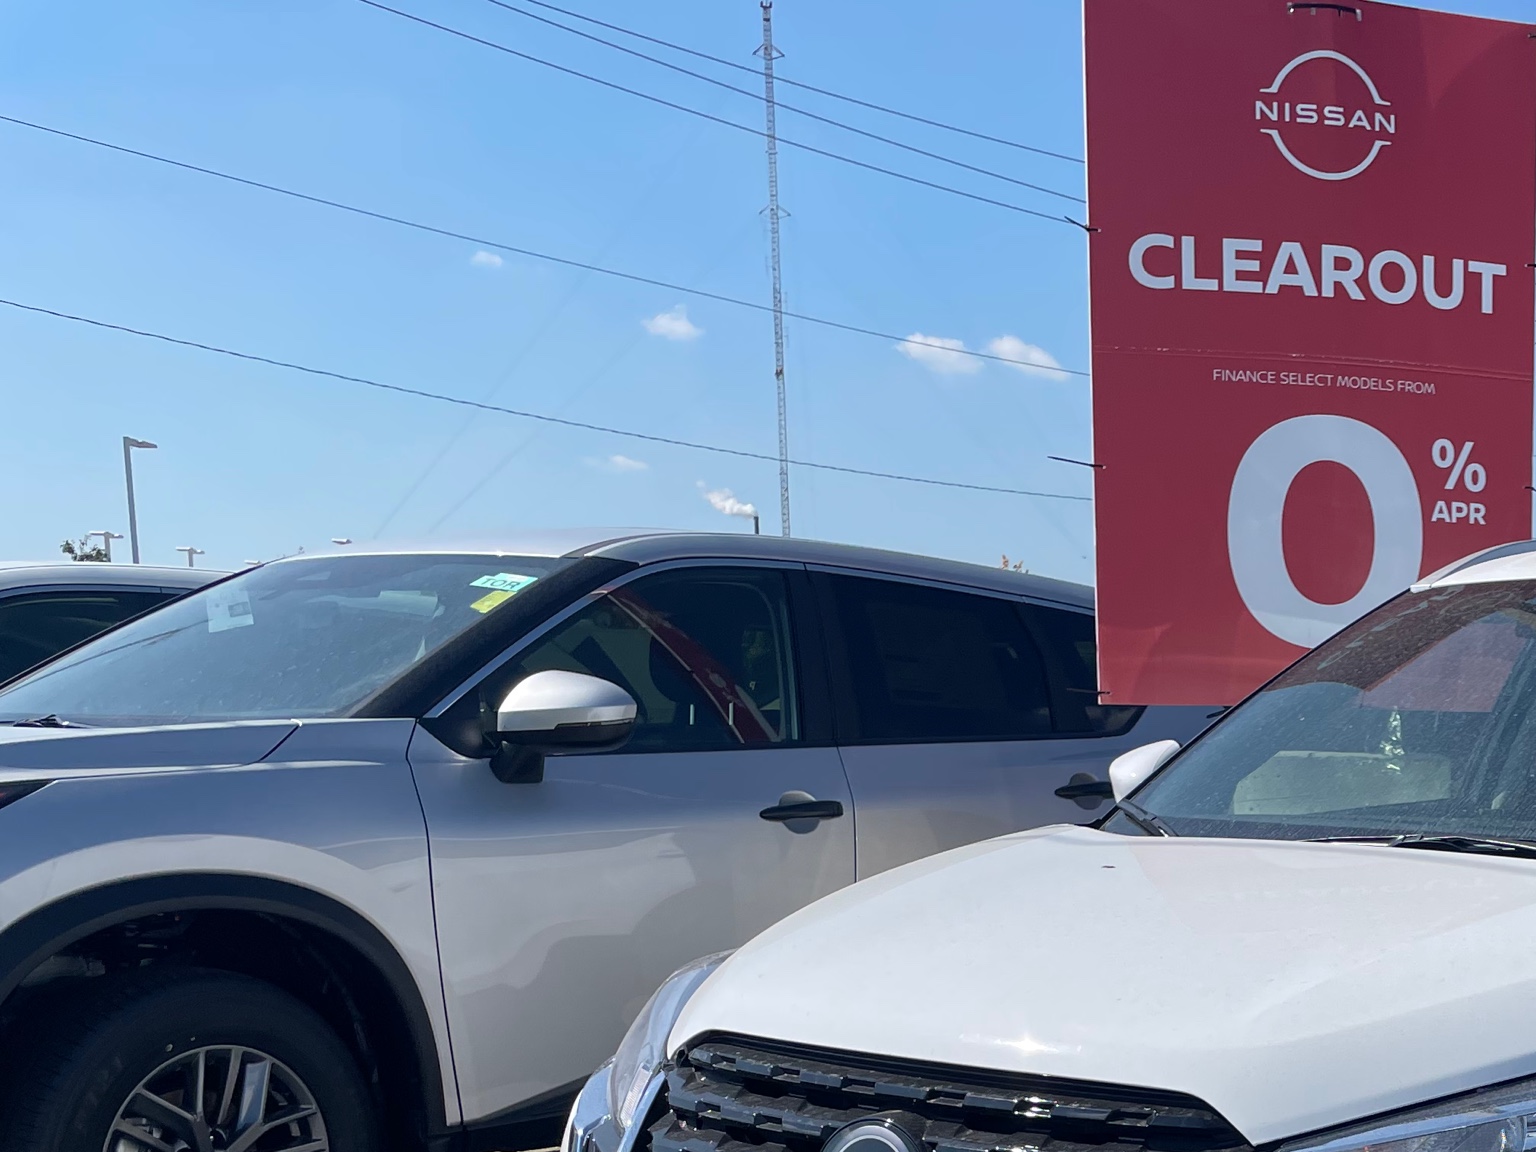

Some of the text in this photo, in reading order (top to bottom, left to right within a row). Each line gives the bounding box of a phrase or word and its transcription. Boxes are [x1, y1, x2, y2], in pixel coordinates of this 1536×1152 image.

[1255, 100, 1396, 134] NISSAN
[1128, 233, 1507, 314] CLEAROUT
[1212, 368, 1436, 395] FINANCE SELECT MODELS FROM
[1431, 500, 1486, 525] APR
[1227, 414, 1423, 650] 0
[1431, 438, 1487, 493] %
